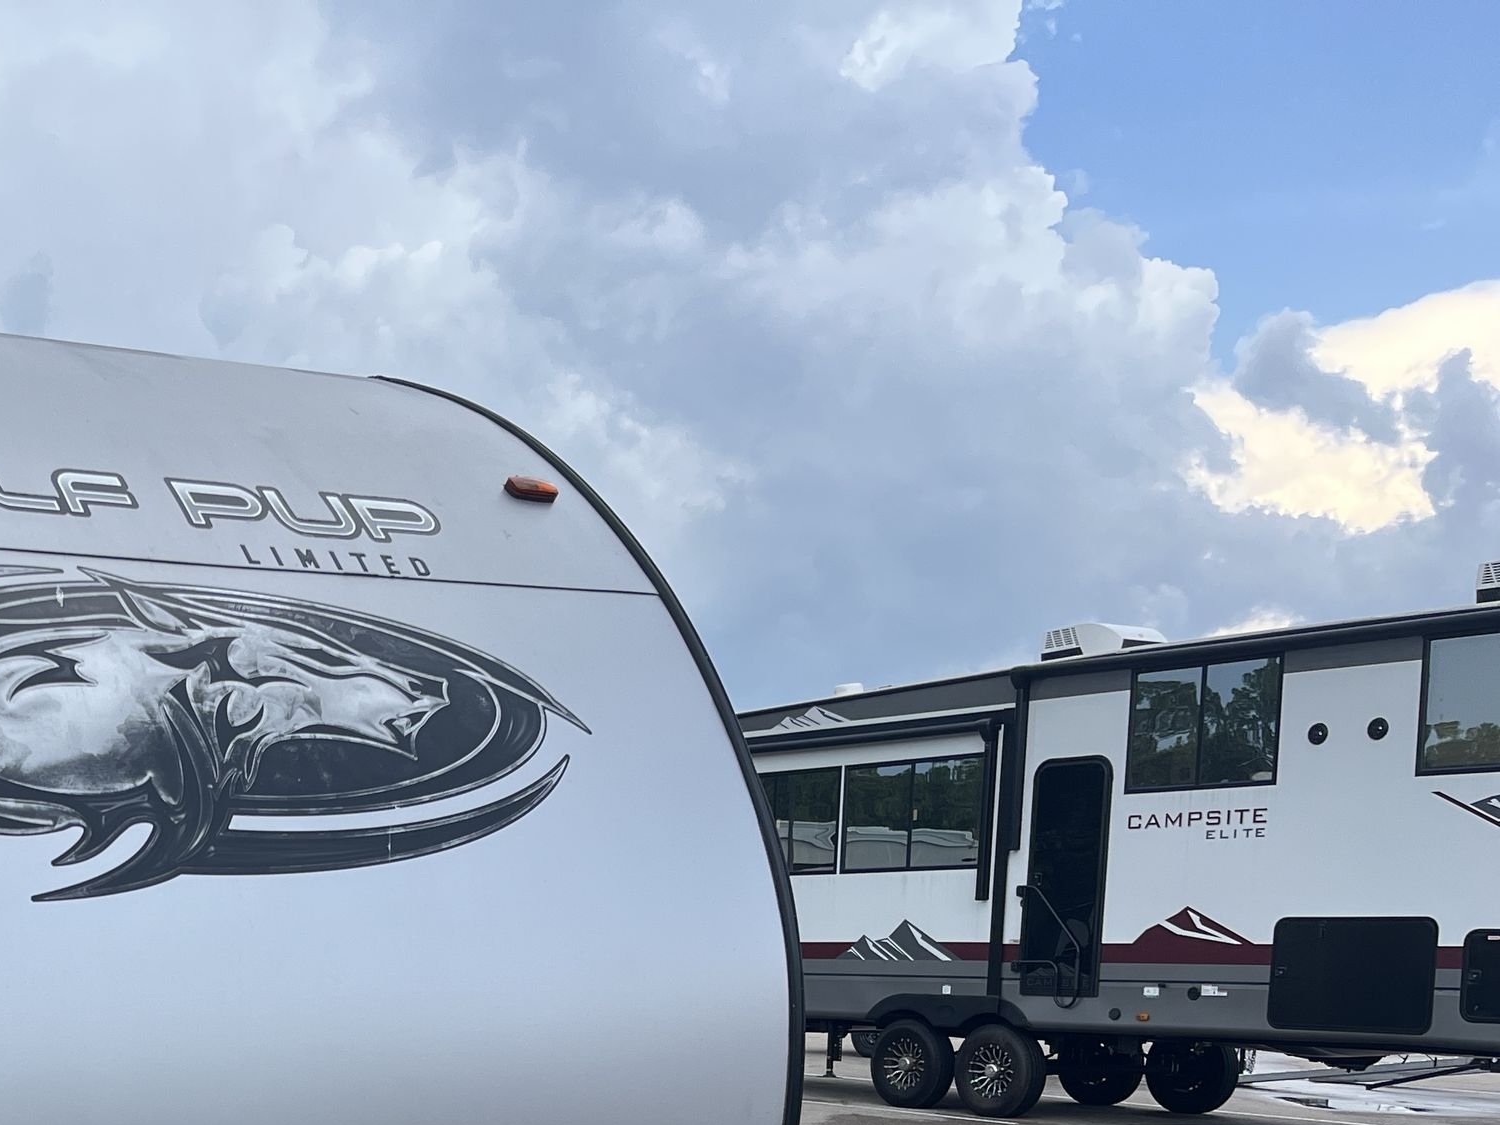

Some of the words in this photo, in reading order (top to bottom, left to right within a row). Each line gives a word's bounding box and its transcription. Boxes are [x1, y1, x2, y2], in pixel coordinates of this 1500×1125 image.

[163, 477, 442, 543] PUP
[239, 544, 431, 576] LIMITED
[1127, 808, 1268, 829] CAMPSITE
[1205, 827, 1266, 840] ELITE
